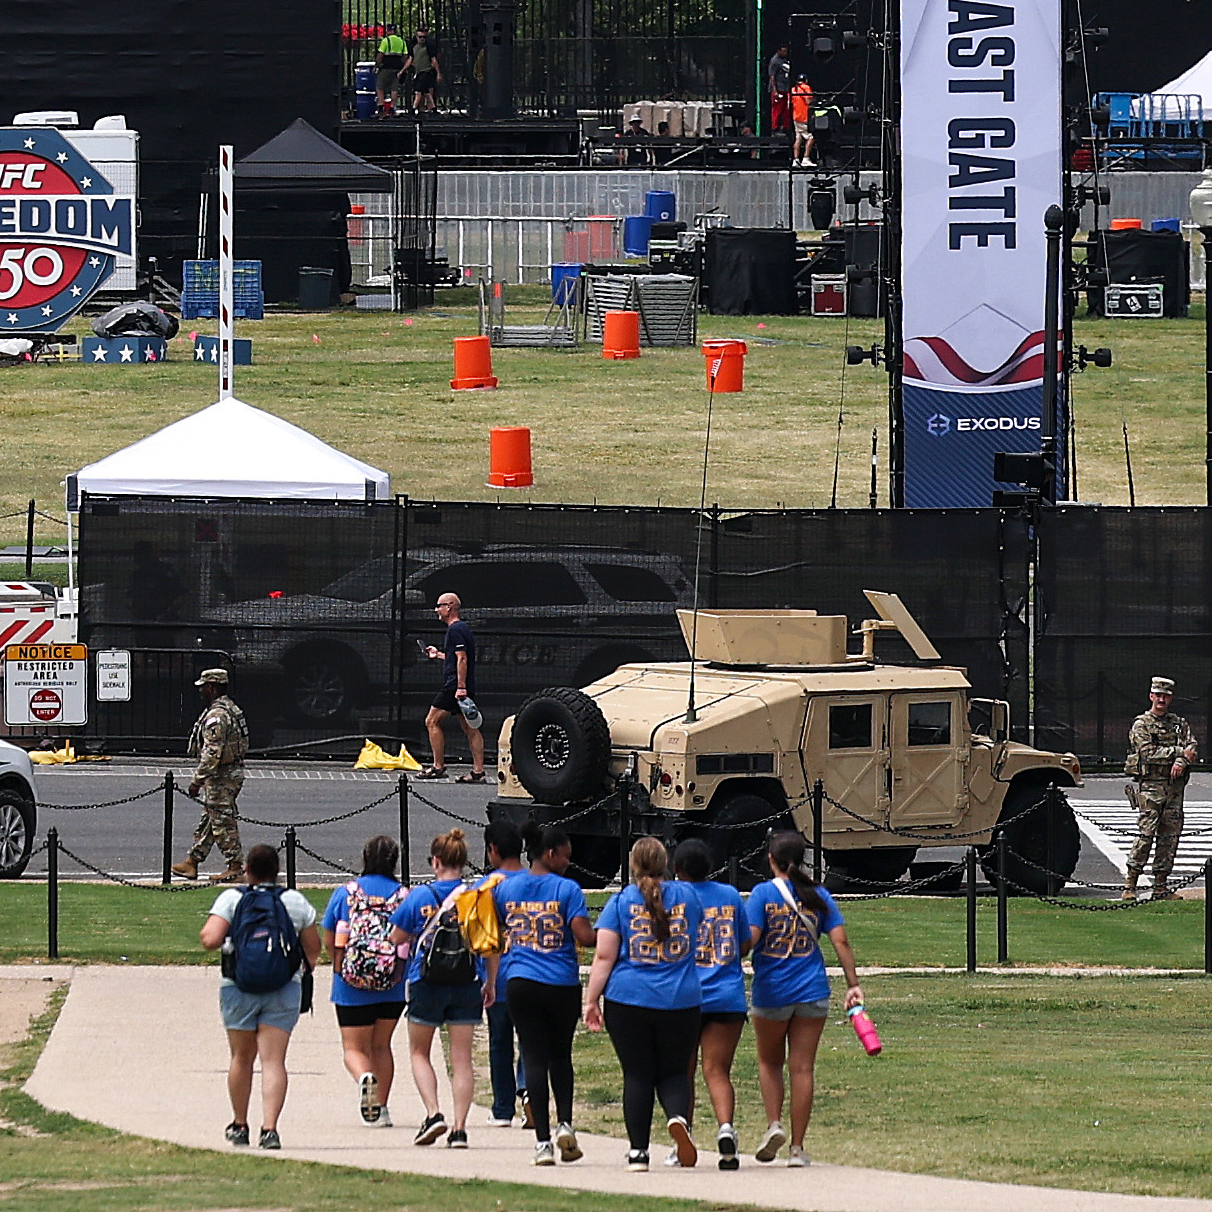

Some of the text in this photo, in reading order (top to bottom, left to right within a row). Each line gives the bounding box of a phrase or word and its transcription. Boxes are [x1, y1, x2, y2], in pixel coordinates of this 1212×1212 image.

[947, 117, 1016, 250] GATE
[957, 417, 1041, 431] EXODUS
[18, 646, 72, 658] NOTICE
[17, 661, 74, 671] RESTRICTED
[33, 672, 58, 680] AREA
